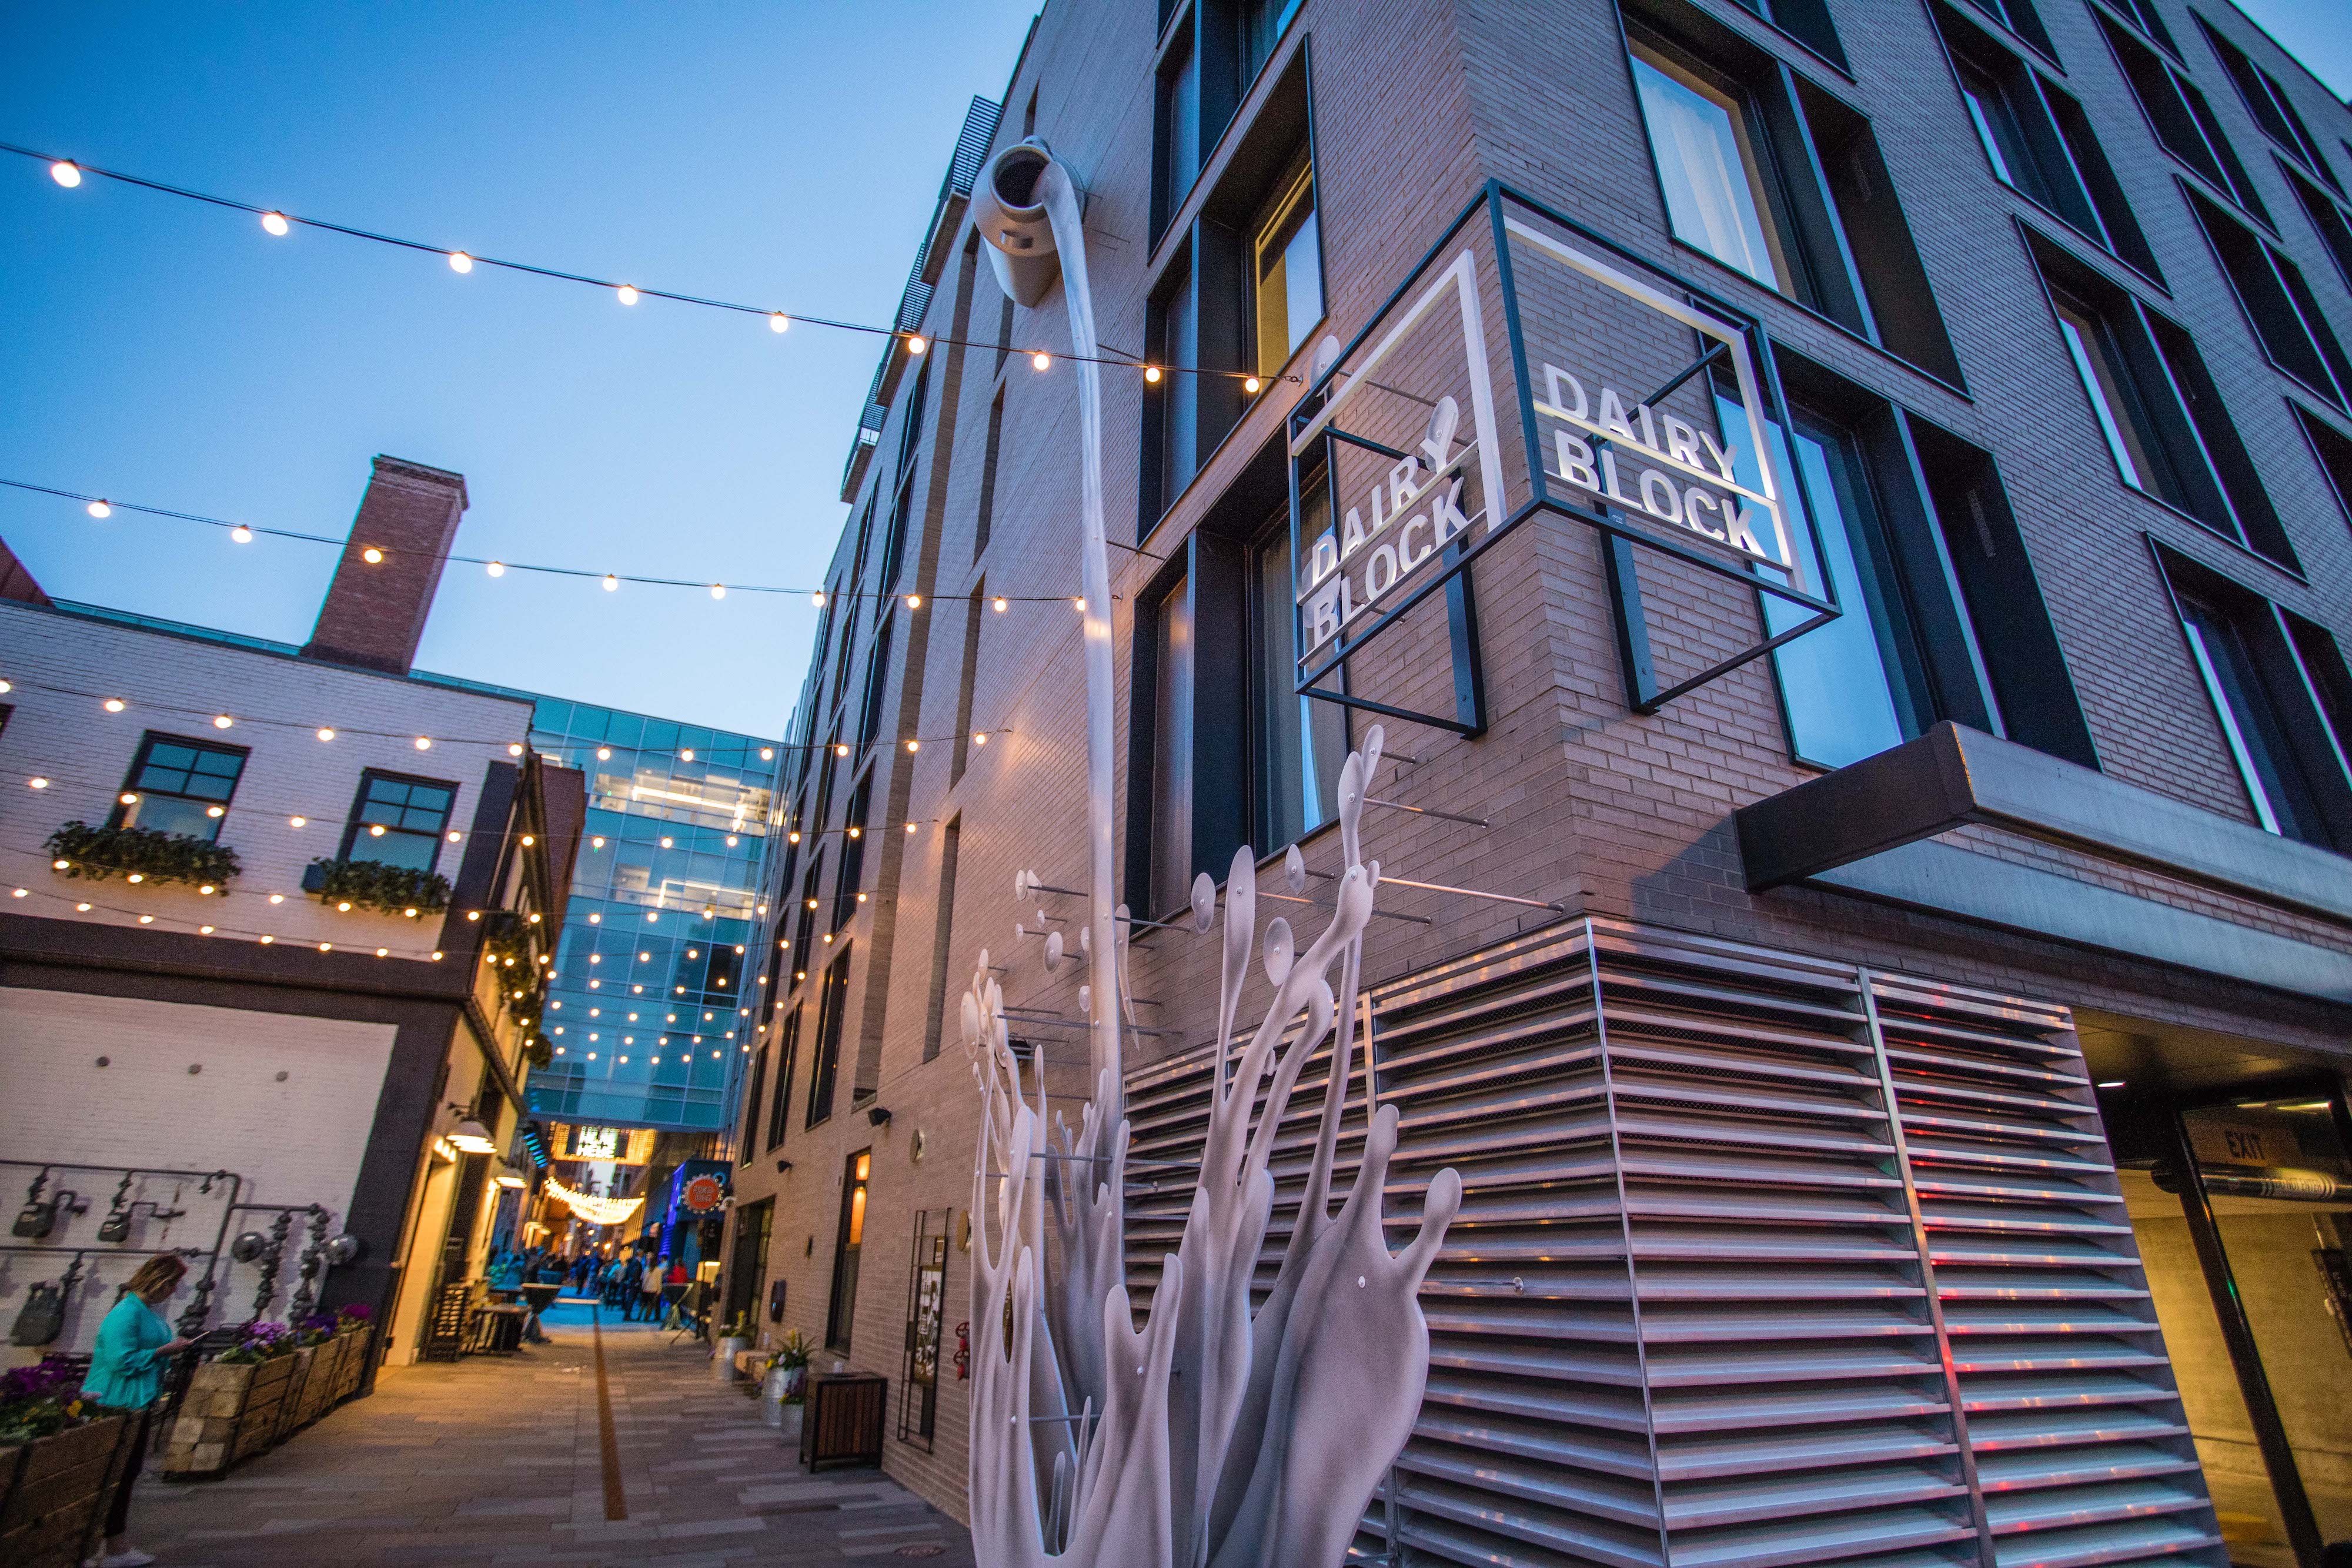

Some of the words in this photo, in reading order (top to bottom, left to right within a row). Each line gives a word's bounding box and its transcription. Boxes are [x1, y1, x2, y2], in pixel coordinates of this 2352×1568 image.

[1543, 363, 1738, 483] DAIRY
[1312, 411, 1457, 587] DAIRY
[1554, 429, 1767, 557] BLOCK
[1314, 476, 1468, 649] BLOCK
[2224, 1129, 2265, 1160] EXIT
